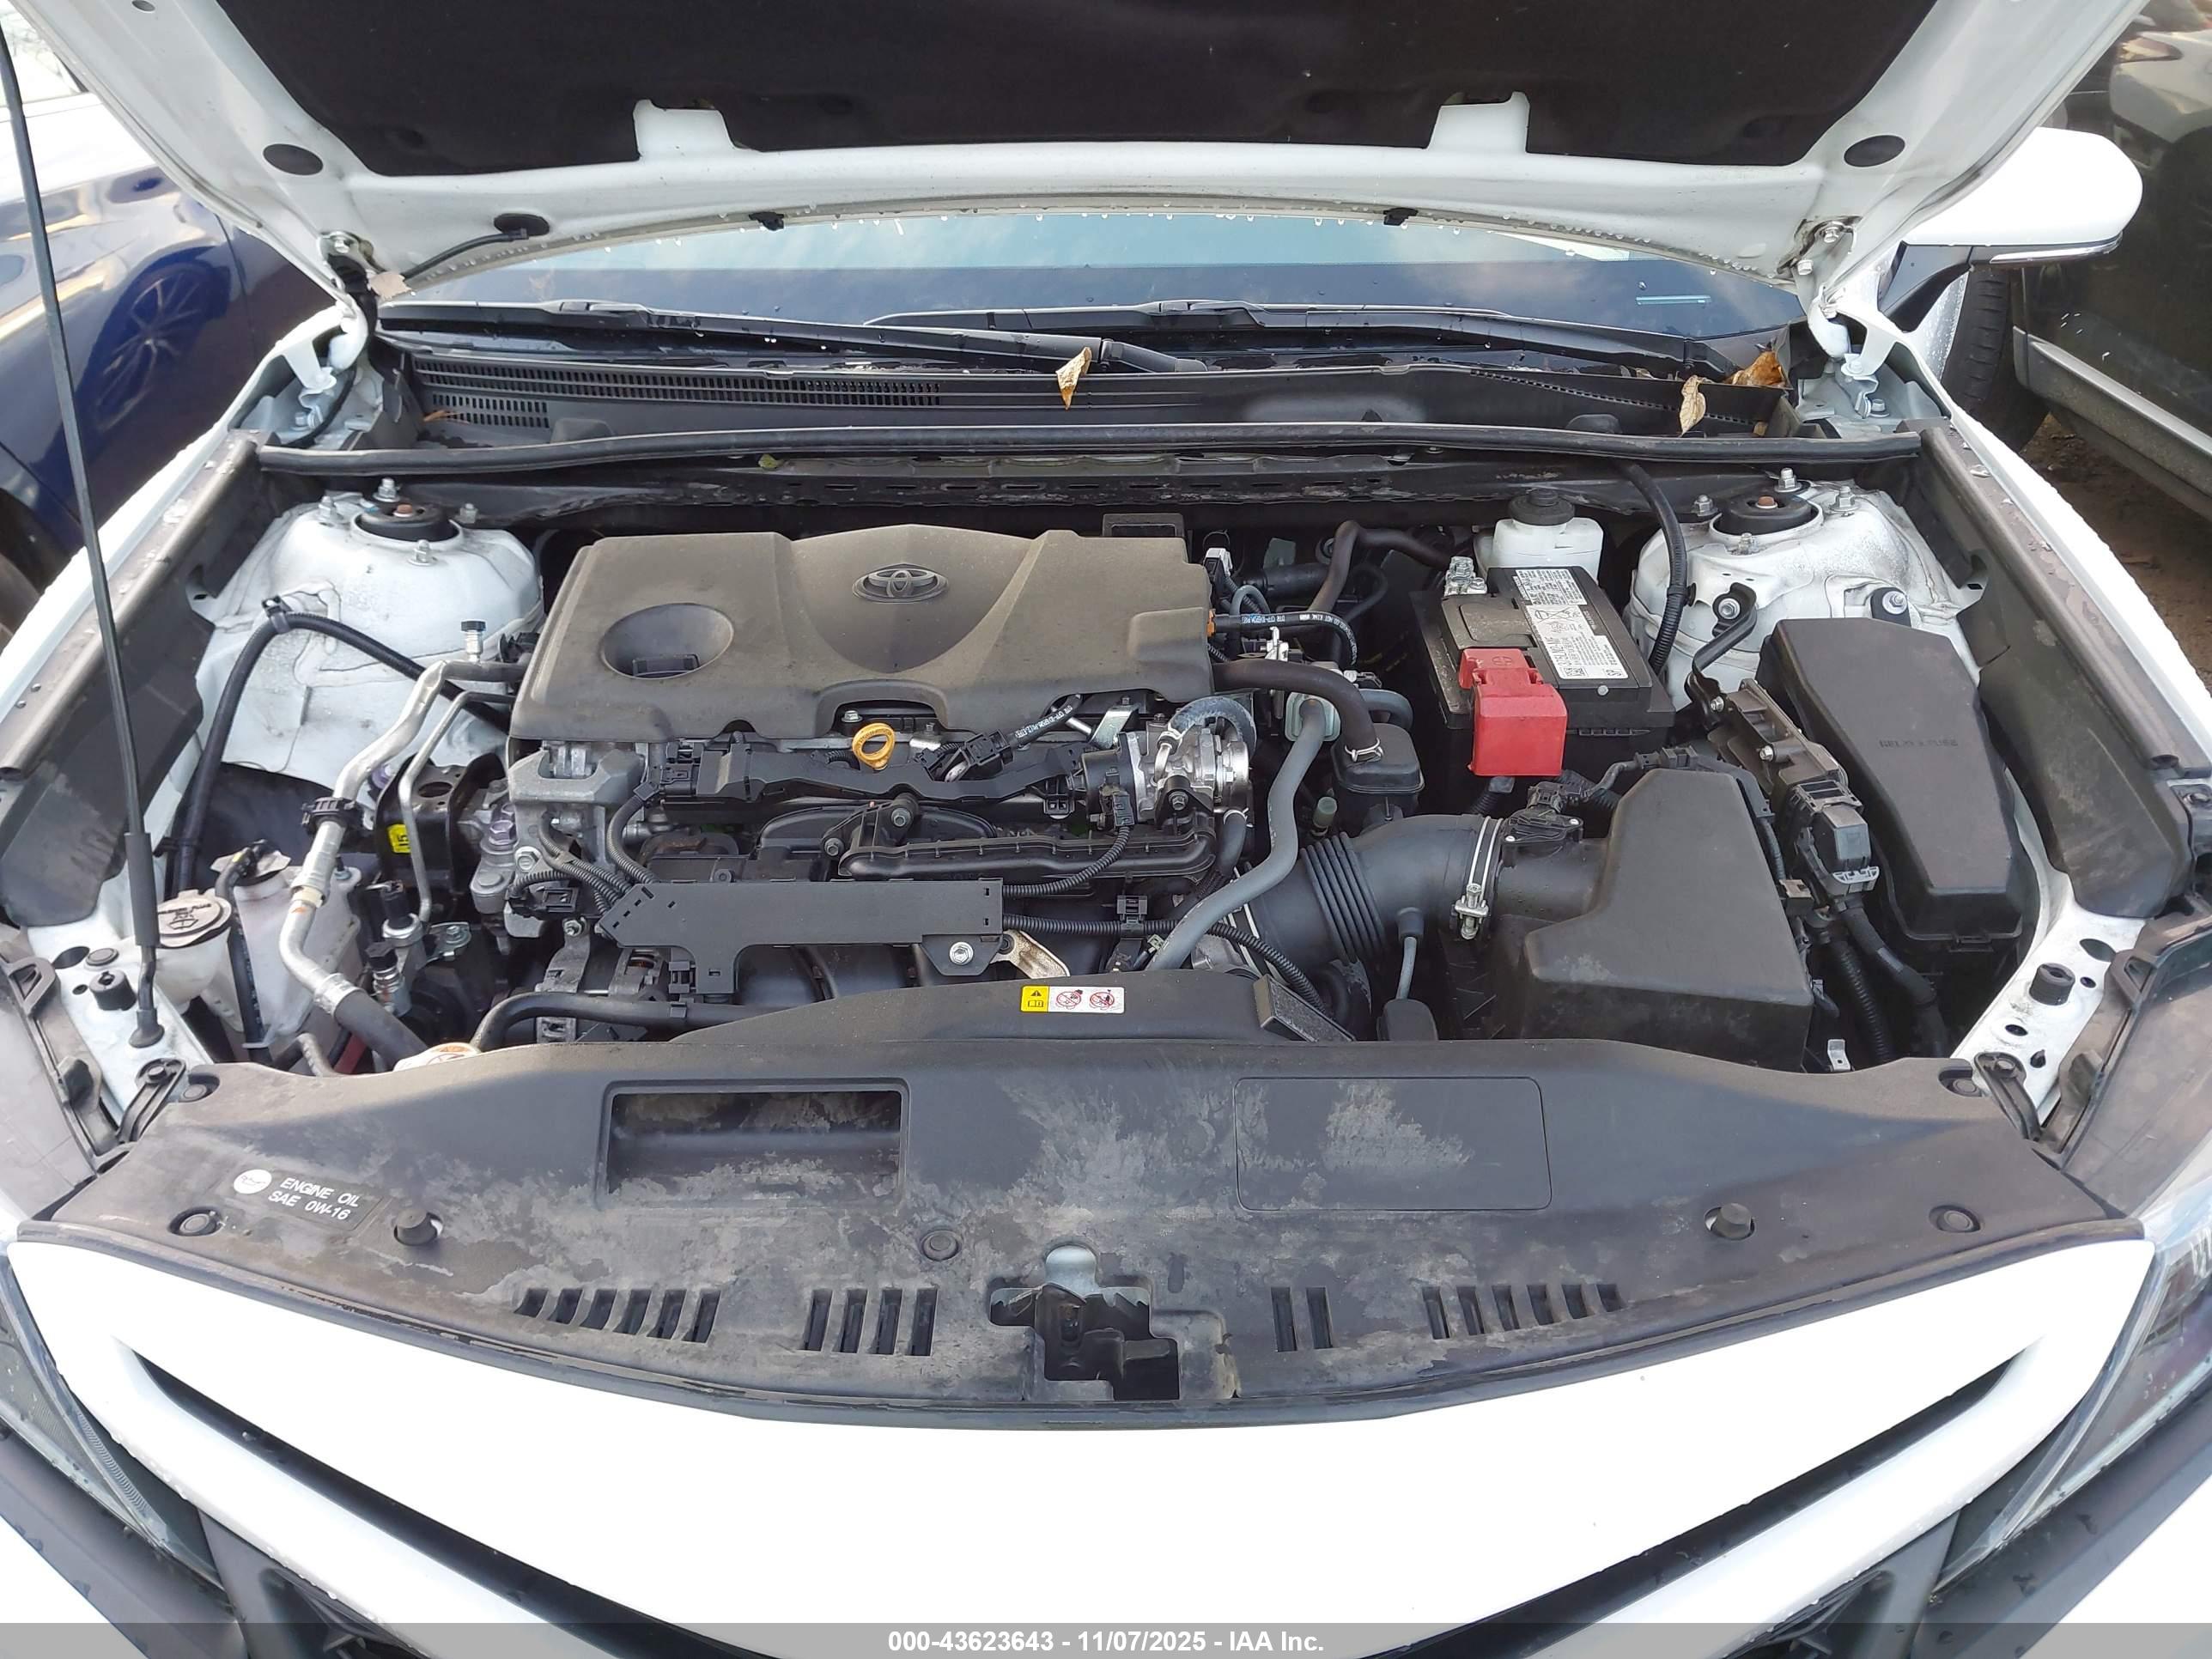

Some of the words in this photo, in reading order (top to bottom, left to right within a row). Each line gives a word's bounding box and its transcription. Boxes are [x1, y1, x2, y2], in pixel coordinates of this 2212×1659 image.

[268, 1190, 301, 1207] SAE
[304, 1200, 351, 1220] 0W-16
[280, 1177, 334, 1200] ENGINE
[337, 1193, 360, 1207] OIL
